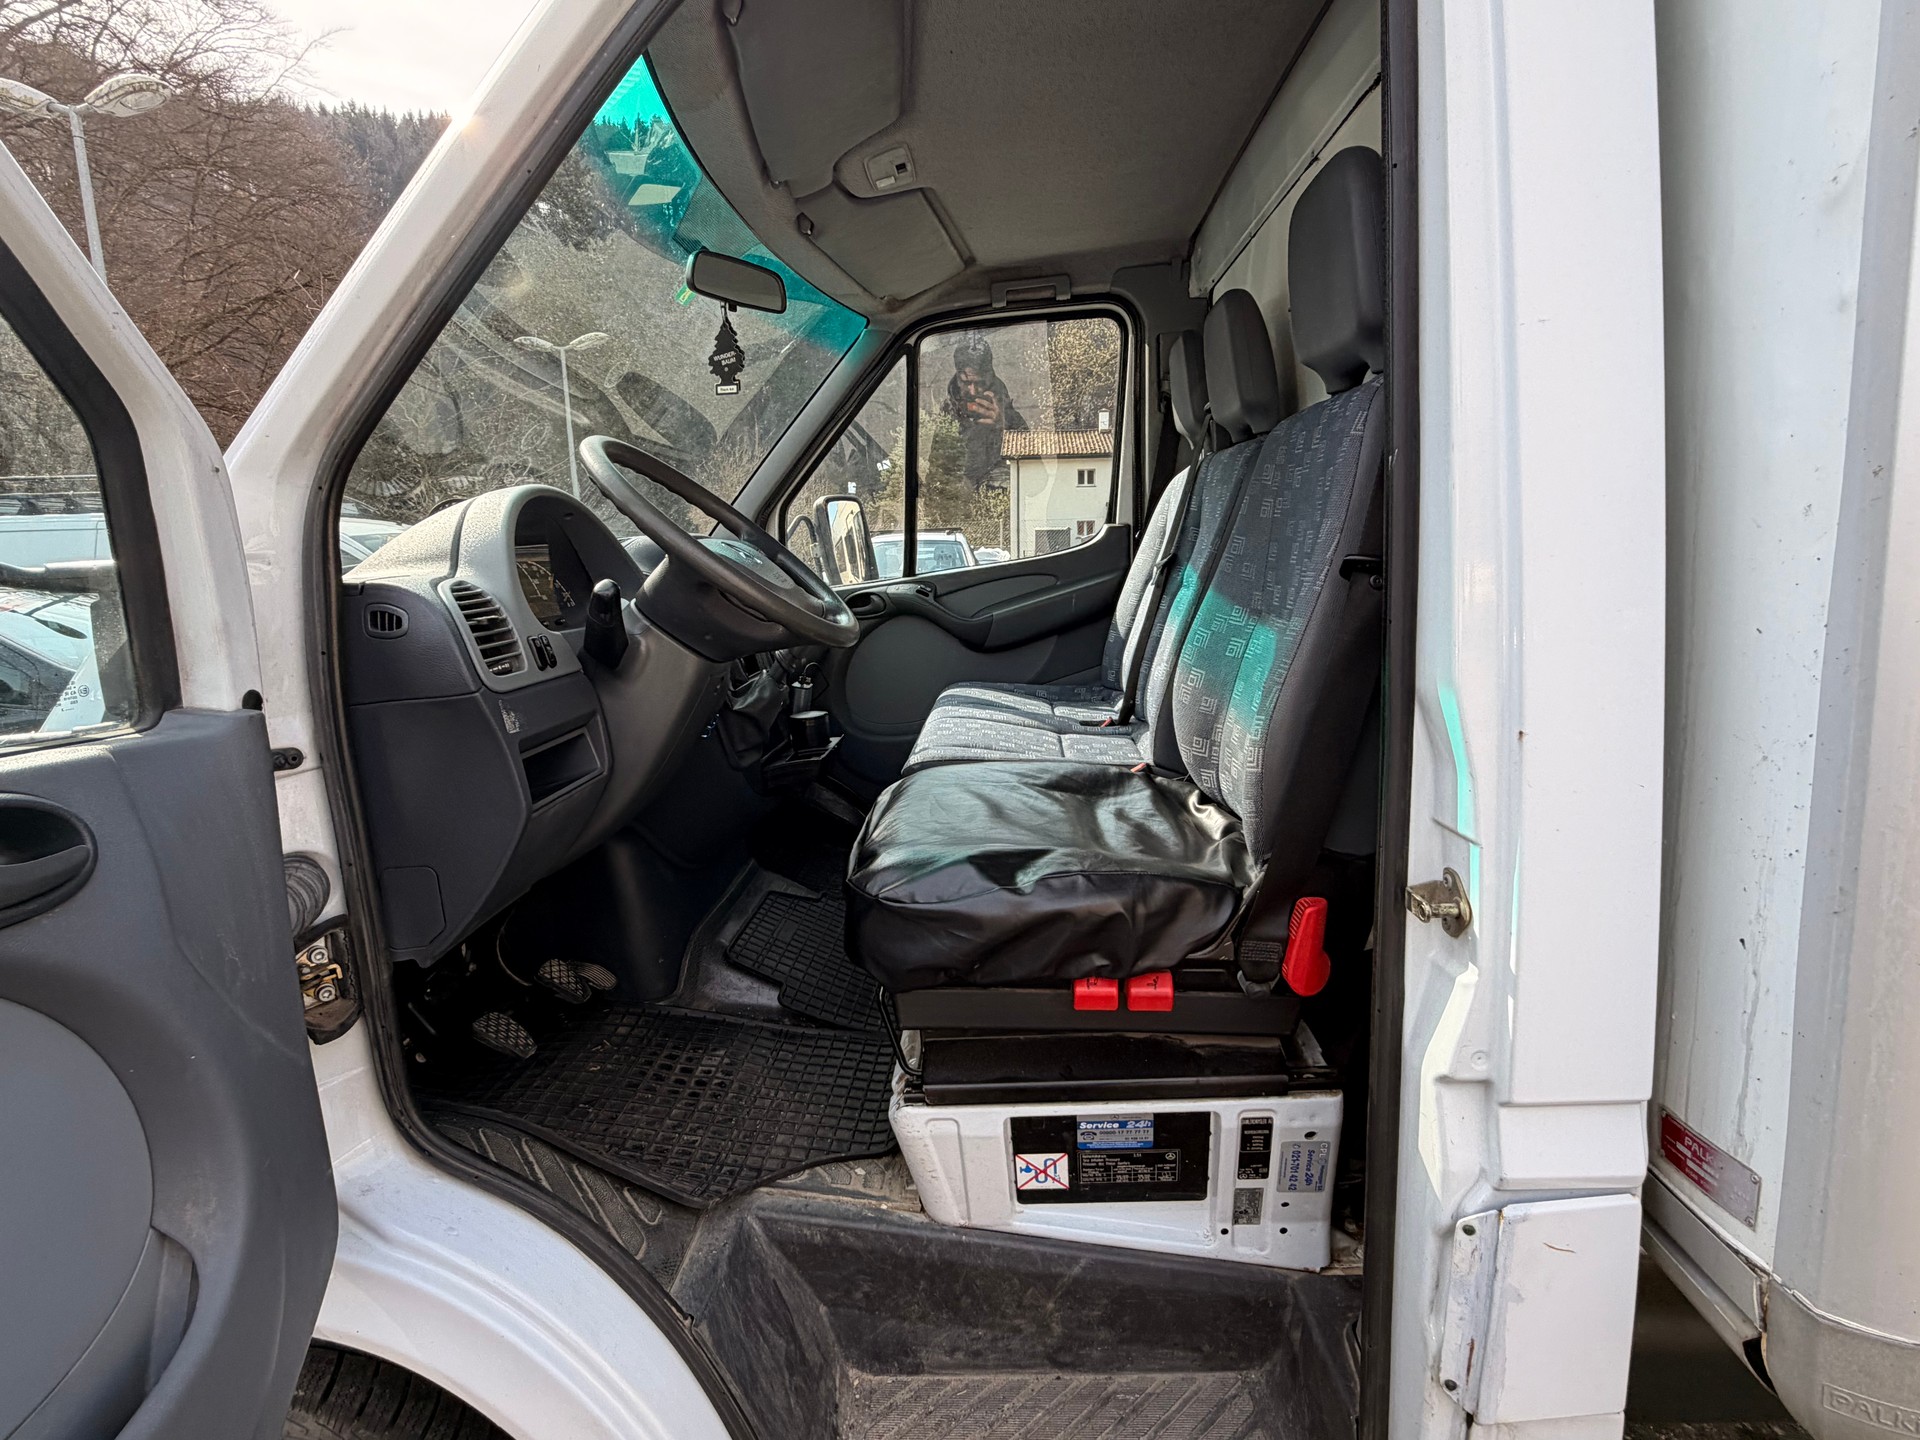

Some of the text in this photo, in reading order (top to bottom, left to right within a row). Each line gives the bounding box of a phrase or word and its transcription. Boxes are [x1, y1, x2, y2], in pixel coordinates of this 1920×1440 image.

[1126, 1120, 1152, 1128] 24h
[1319, 1142, 1328, 1158] CPL
[1304, 1149, 1316, 1186] Service 24h
[1288, 1174, 1298, 1182] 42
[1829, 1389, 1920, 1435] PALK
